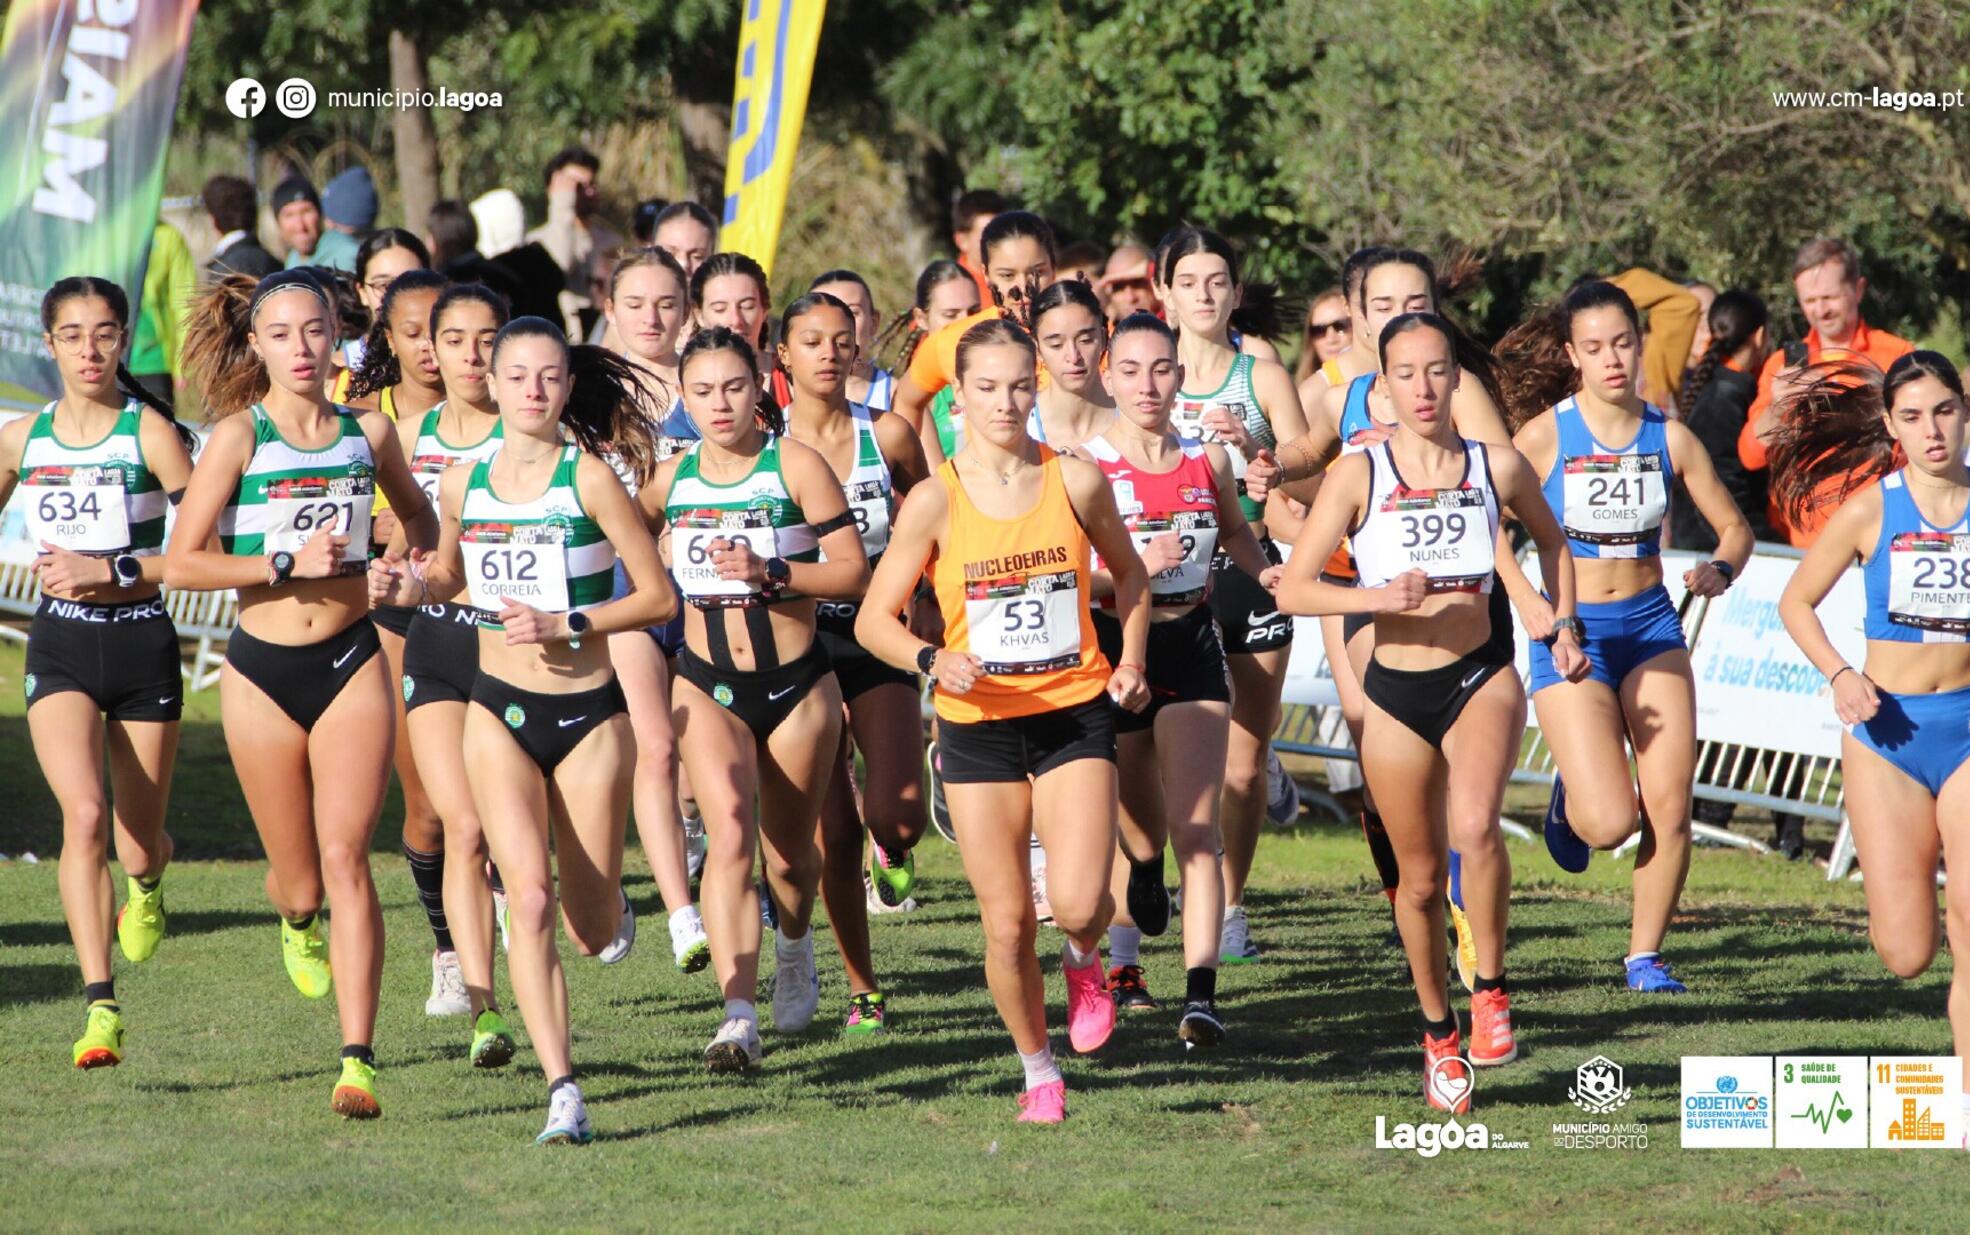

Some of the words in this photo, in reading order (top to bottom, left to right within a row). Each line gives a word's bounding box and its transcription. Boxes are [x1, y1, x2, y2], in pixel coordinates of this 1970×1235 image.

[38, 490, 102, 522] 634
[1588, 477, 1645, 506] 241
[293, 501, 353, 532] 621
[1592, 509, 1638, 520] GOMES
[56, 523, 86, 536] RIJO
[1400, 512, 1467, 548] 399
[480, 549, 538, 581] 612
[963, 546, 1067, 579] NUCLEOEIRAS
[1409, 547, 1460, 563] NUNES
[682, 567, 721, 580] FERN
[481, 583, 542, 596] CORREIA
[47, 600, 107, 622] NIKE
[113, 599, 165, 623] PRO
[1004, 600, 1045, 631] 53
[1000, 631, 1050, 647] KHVAS
[1719, 652, 1754, 688] sua
